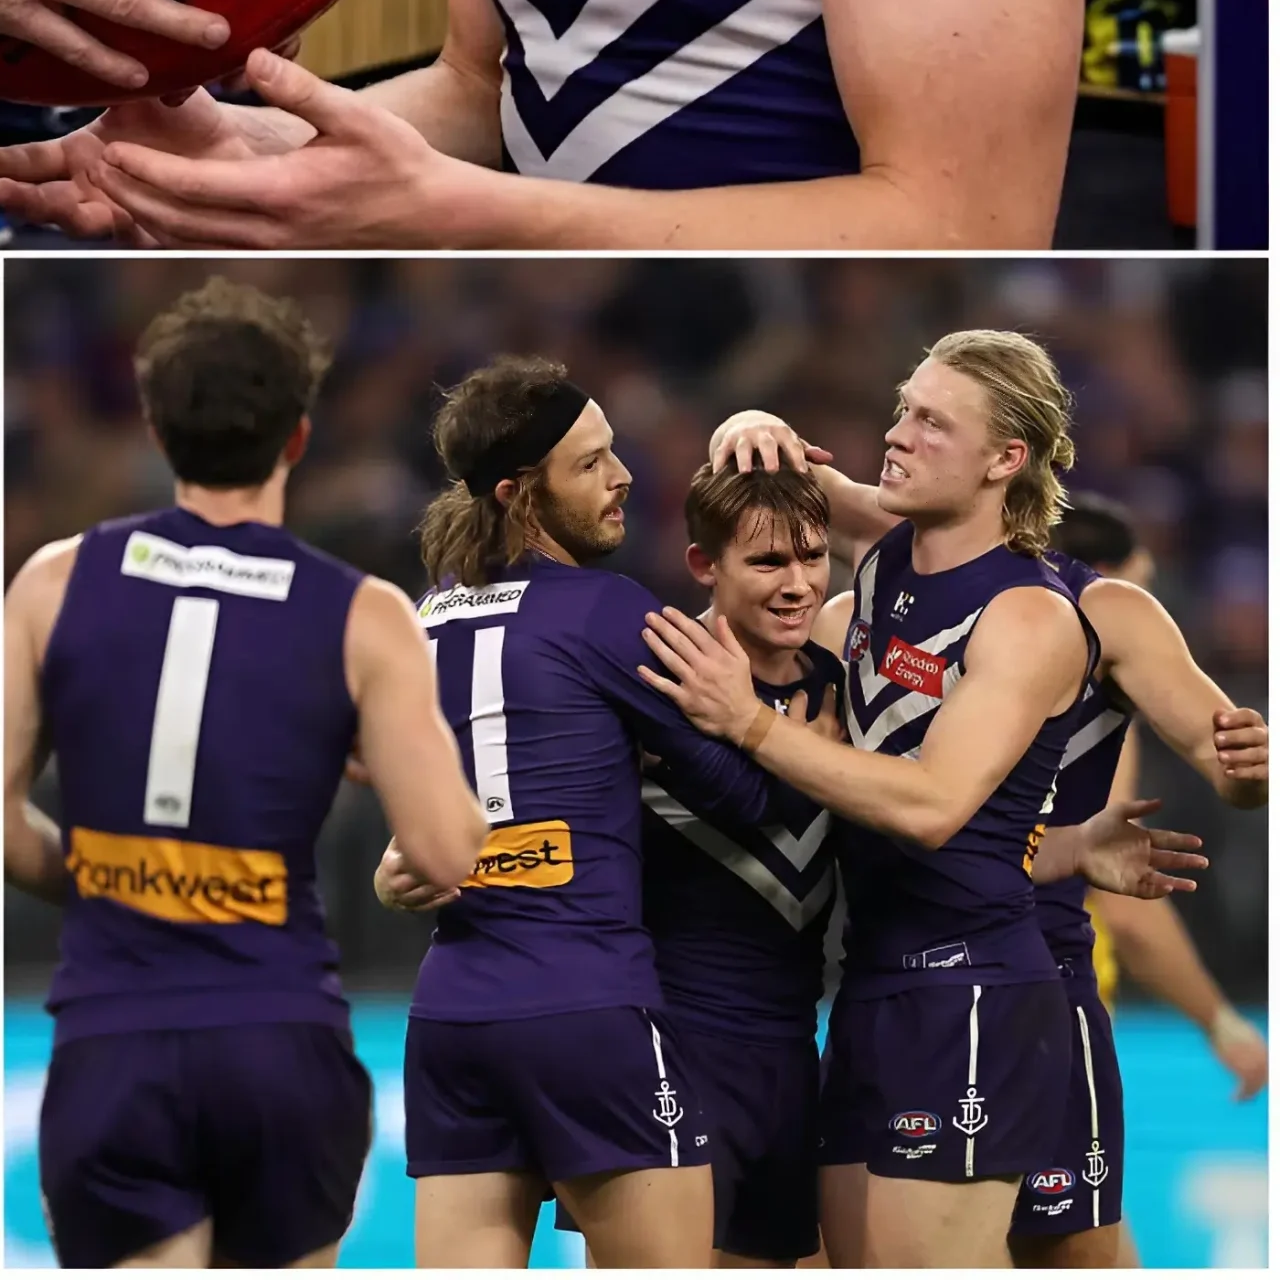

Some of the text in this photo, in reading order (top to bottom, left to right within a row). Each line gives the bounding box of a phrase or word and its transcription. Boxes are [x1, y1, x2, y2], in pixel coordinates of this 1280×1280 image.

[143, 596, 220, 829] 1
[895, 1117, 936, 1130] AFL
[1033, 1173, 1072, 1188] AFL
